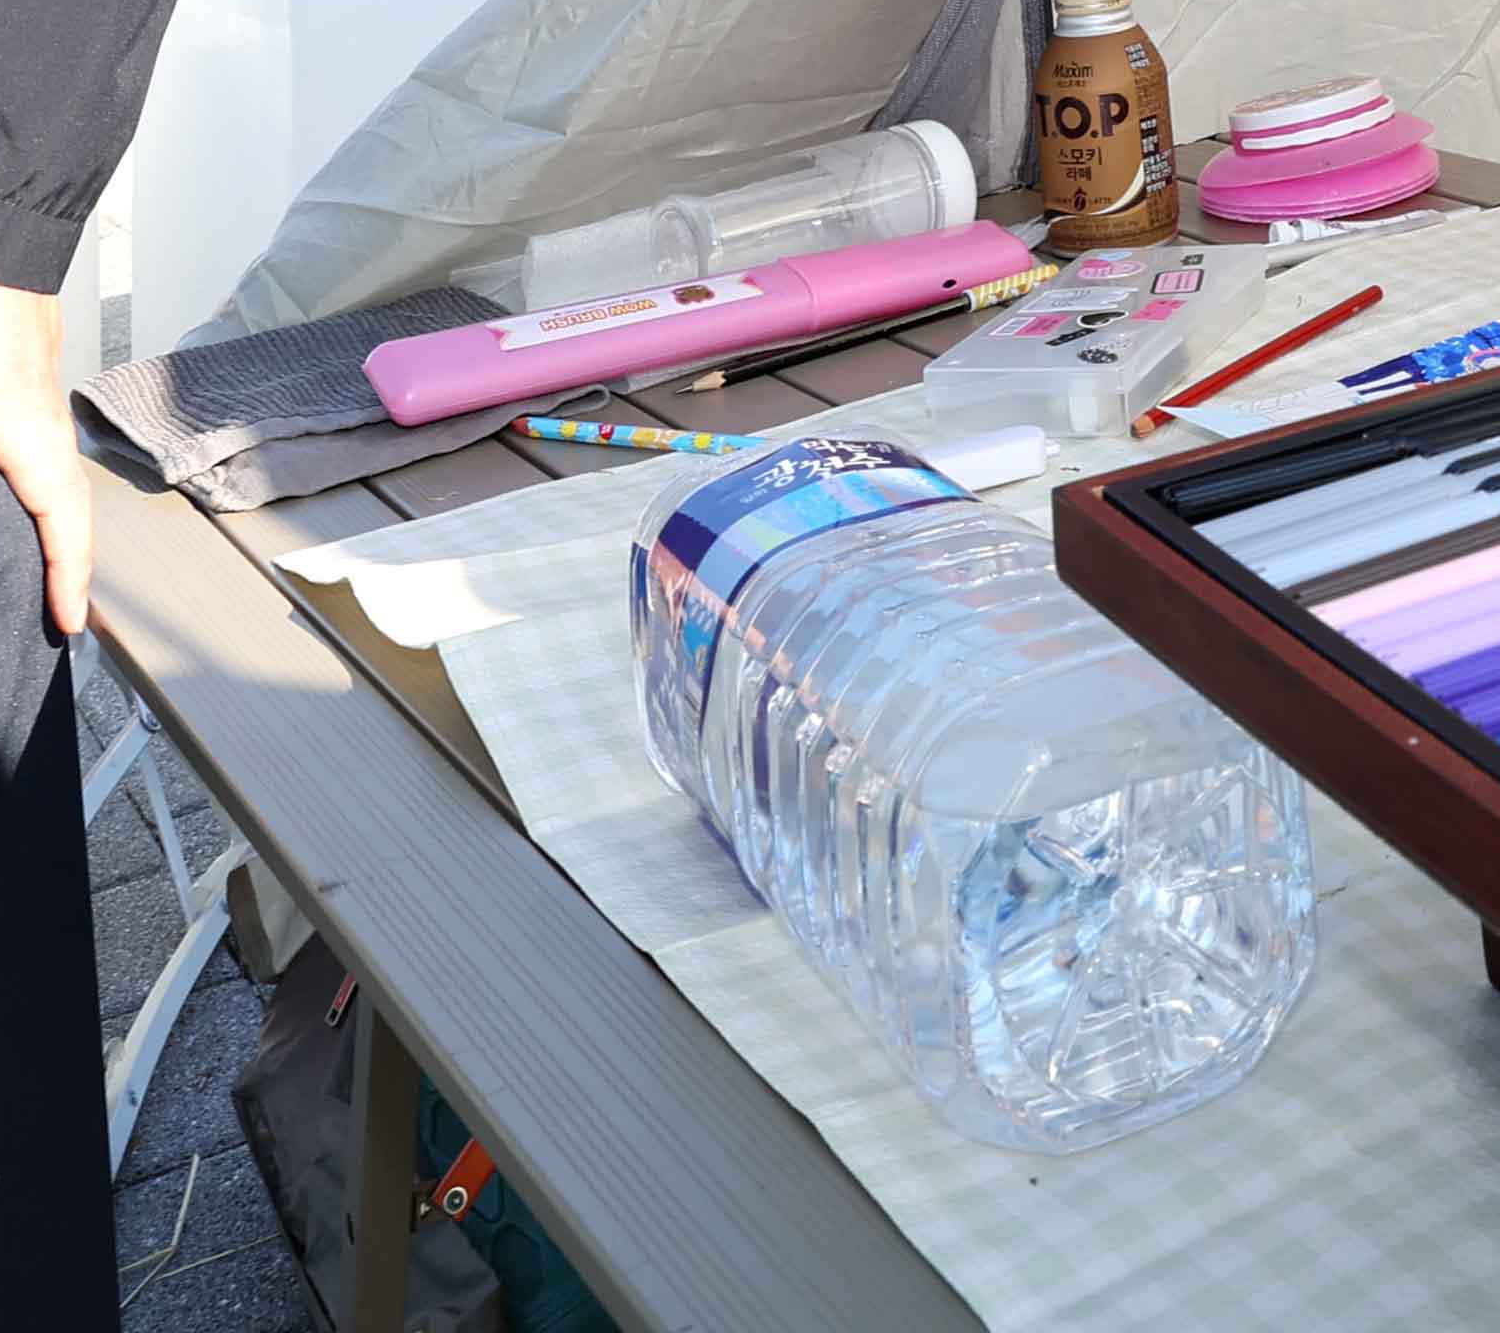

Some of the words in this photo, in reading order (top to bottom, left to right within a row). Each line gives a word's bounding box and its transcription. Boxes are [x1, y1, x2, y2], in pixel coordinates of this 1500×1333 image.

[1052, 60, 1094, 78] Maxim
[1035, 92, 1130, 140] T.O.P
[1058, 147, 1103, 166] 스모키
[1066, 167, 1092, 181] 라떼
[539, 308, 609, 332] BRUSH
